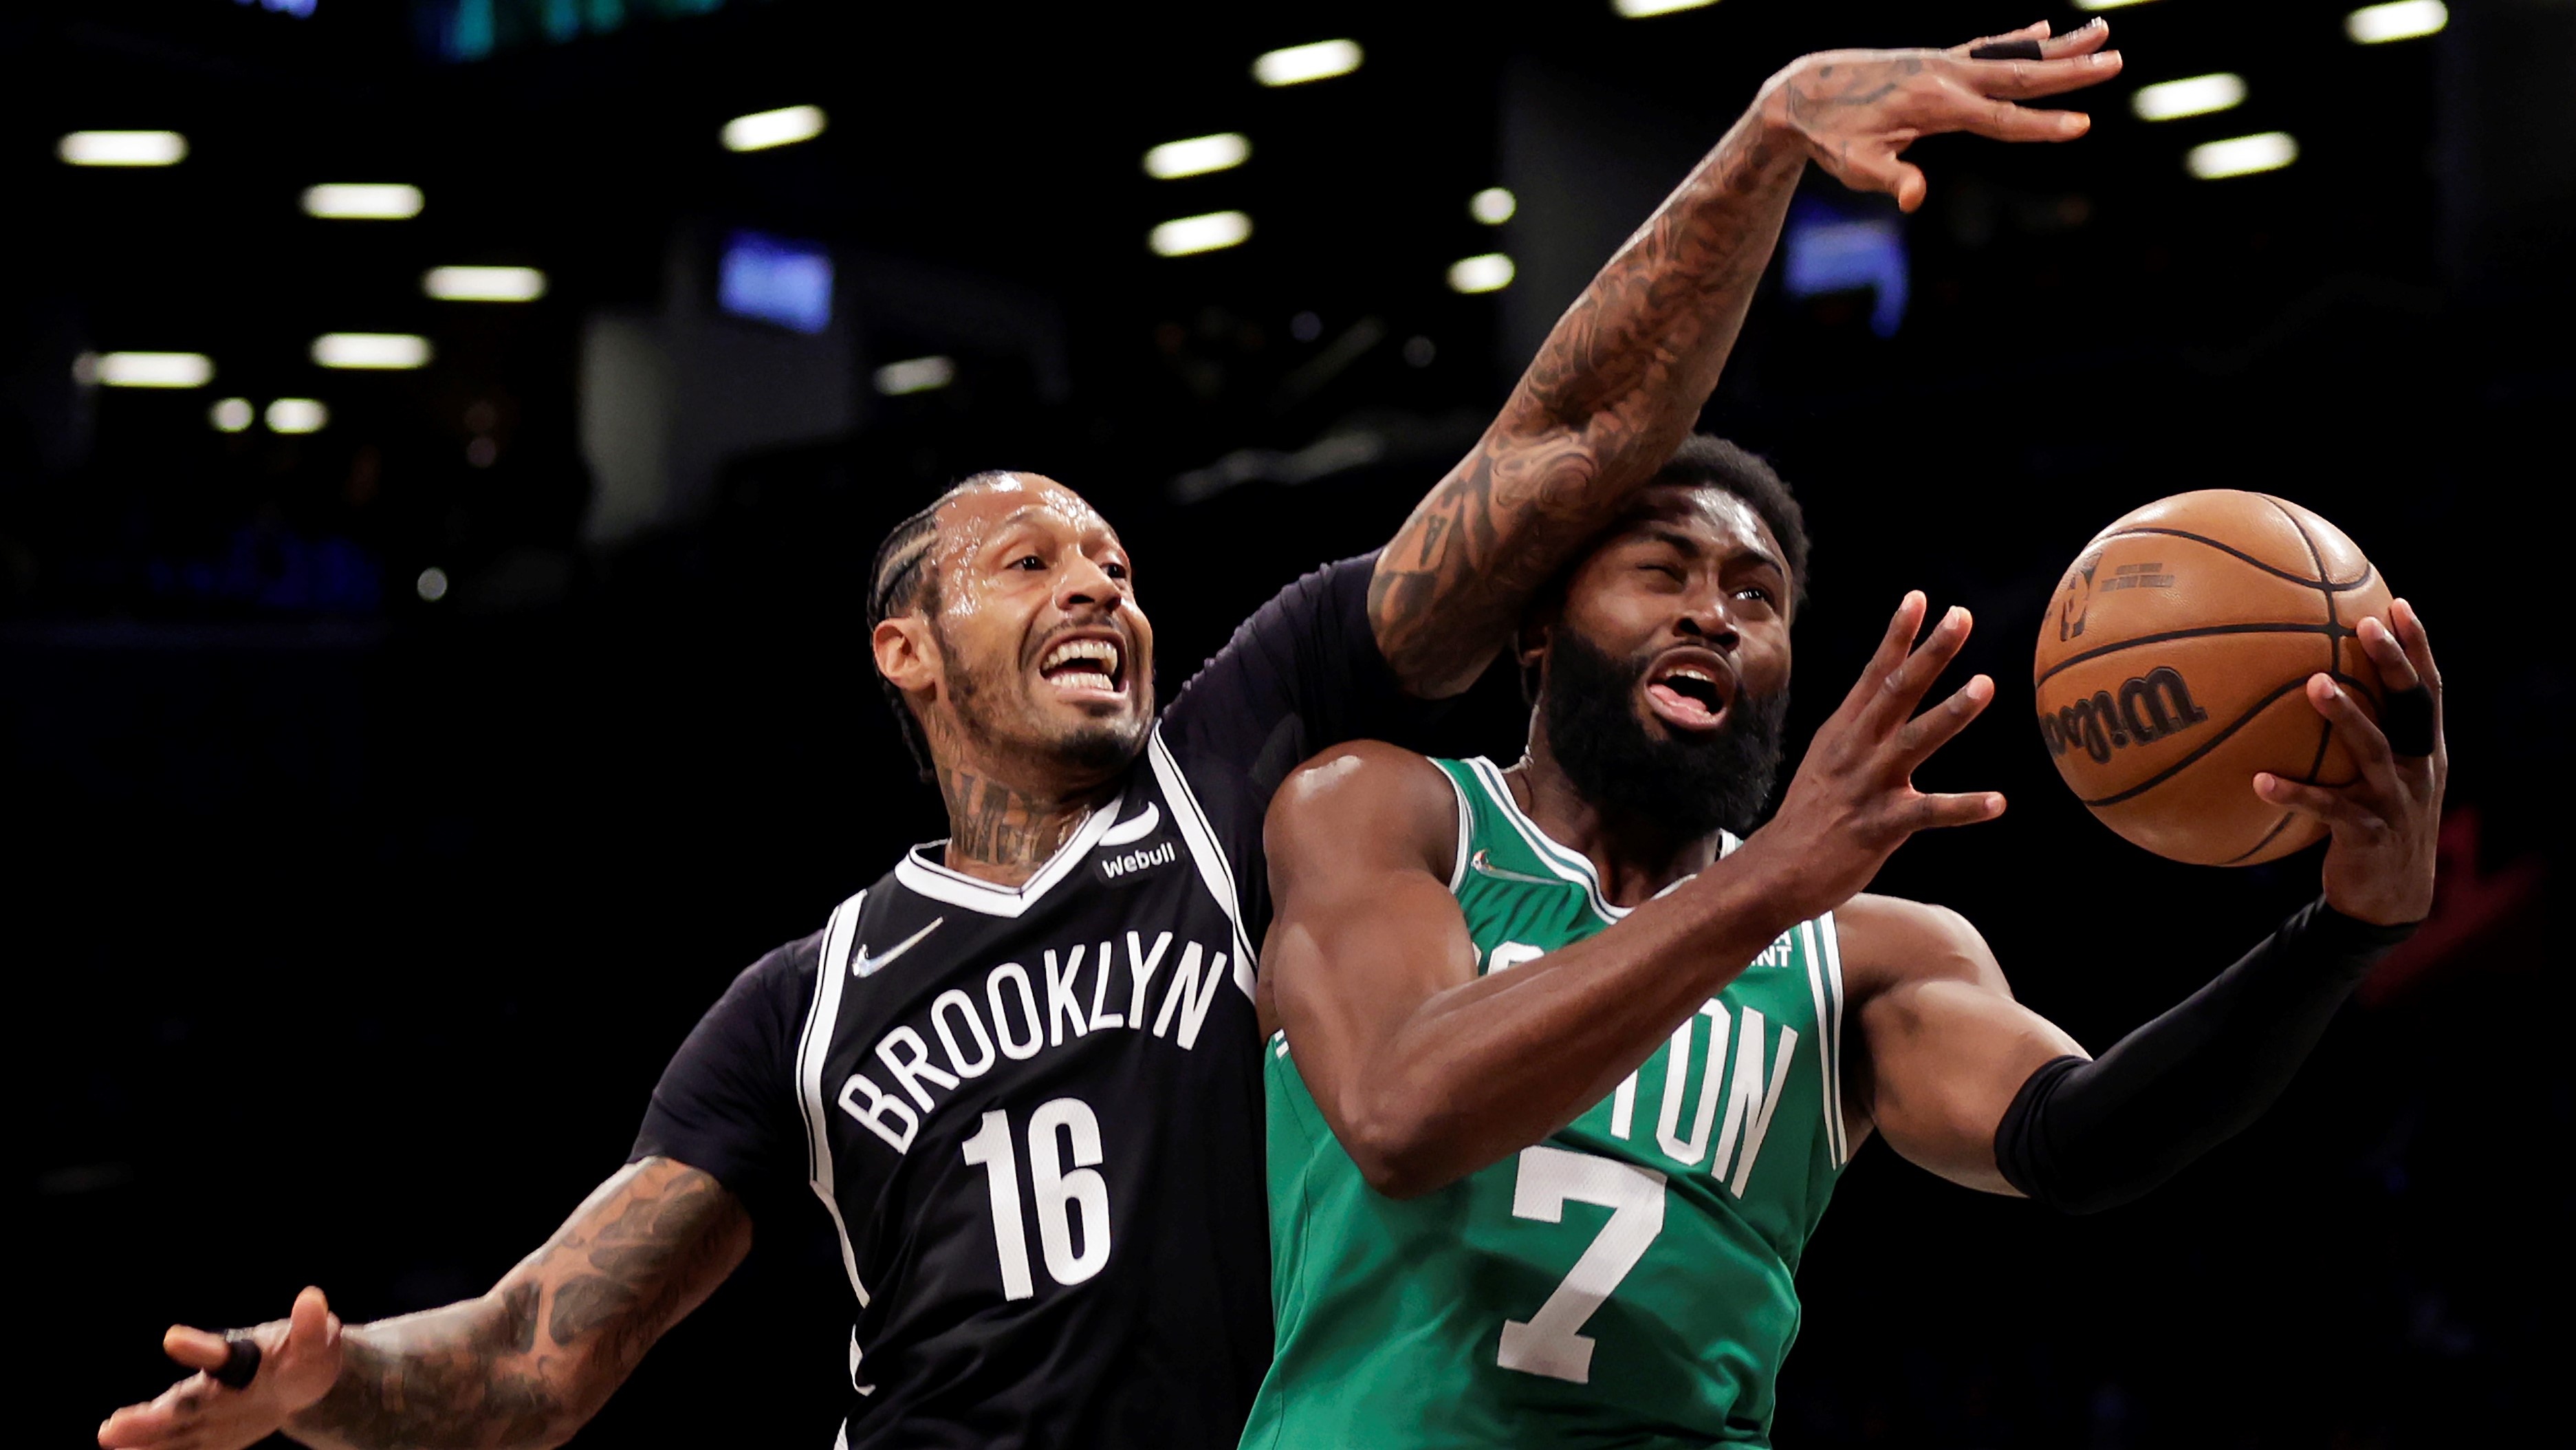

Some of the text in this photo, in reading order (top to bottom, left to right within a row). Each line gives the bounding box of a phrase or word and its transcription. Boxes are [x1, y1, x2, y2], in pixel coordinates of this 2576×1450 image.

[1102, 842, 1176, 878] Webull
[838, 930, 1227, 1155] BROOKLYN
[962, 1097, 1111, 1301] 16
[1497, 1145, 1667, 1385] 7
